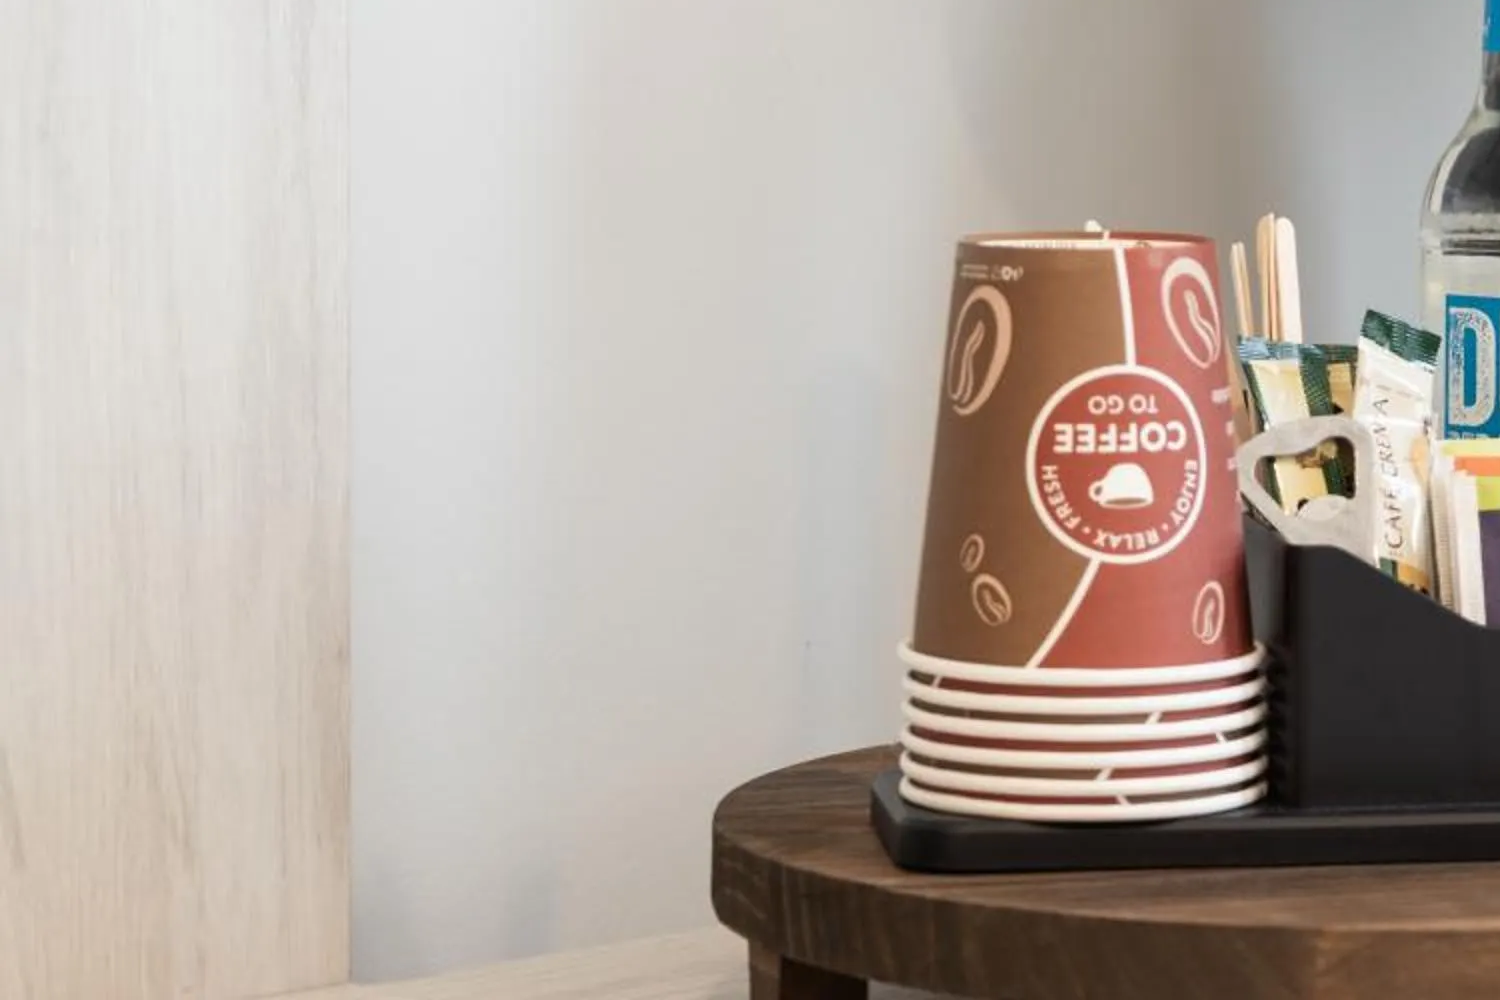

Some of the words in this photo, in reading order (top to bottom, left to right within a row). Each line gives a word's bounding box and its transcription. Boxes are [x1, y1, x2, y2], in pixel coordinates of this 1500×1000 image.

[1087, 394, 1125, 415] GO
[1128, 393, 1160, 415] TO
[1053, 420, 1188, 454] COFFEE
[1041, 464, 1082, 530] FRESH
[1169, 459, 1199, 525] ENJOY
[1093, 528, 1160, 550] RELAX
